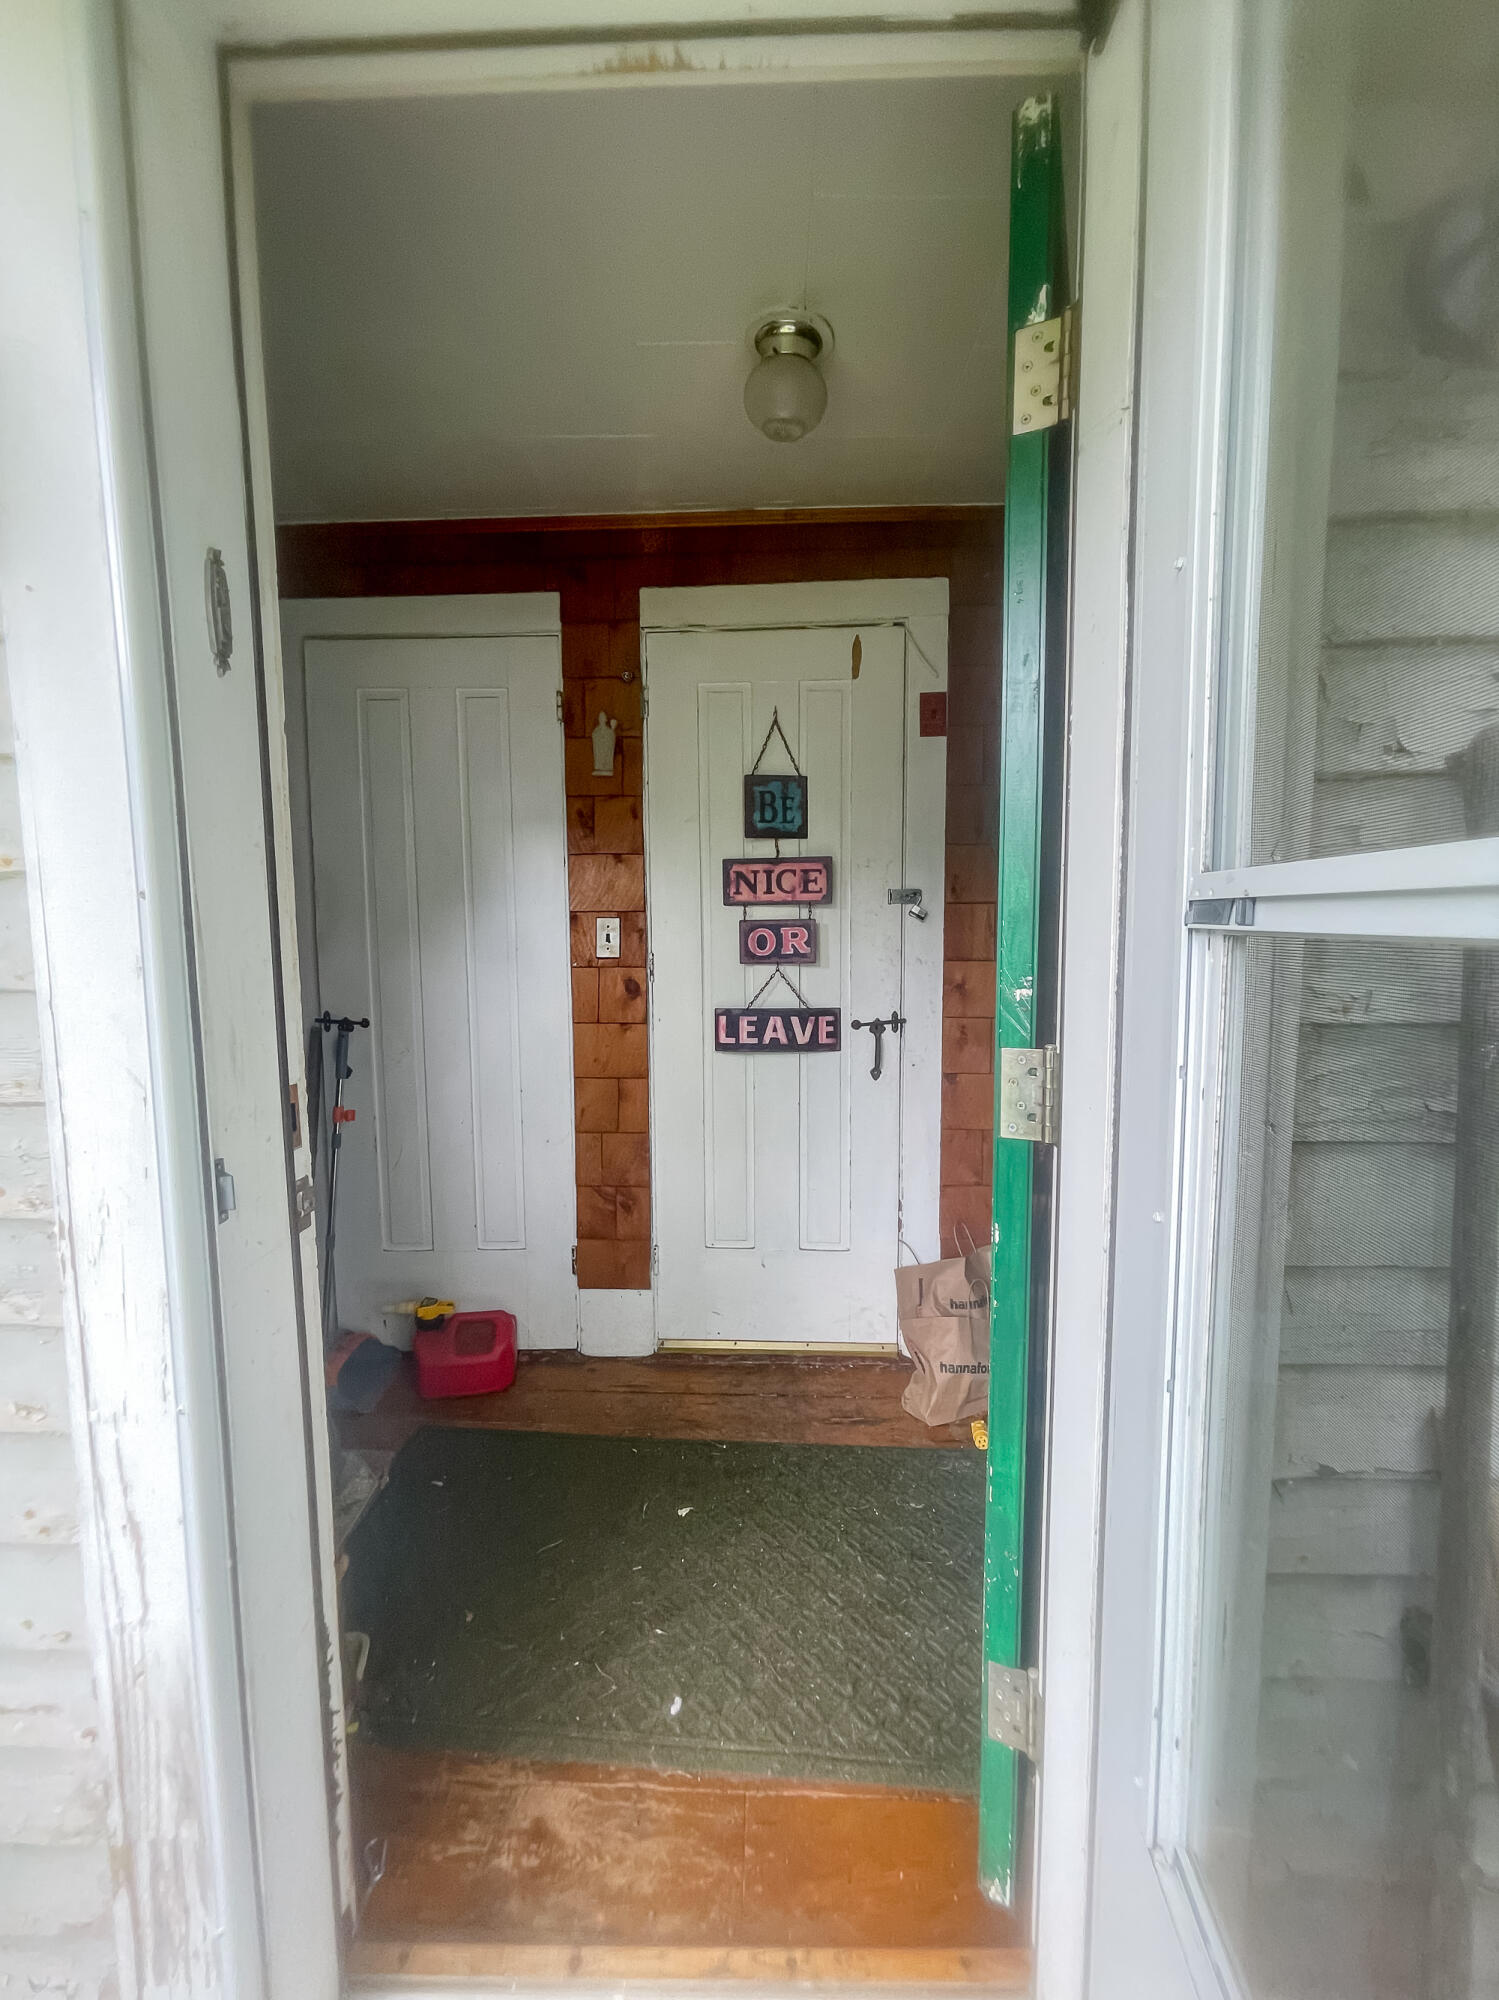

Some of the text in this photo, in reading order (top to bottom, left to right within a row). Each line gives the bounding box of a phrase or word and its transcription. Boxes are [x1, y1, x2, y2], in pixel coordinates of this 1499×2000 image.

[758, 790, 795, 825] BE
[732, 868, 823, 895] NICE
[747, 927, 811, 956] OR
[717, 1015, 837, 1045] LEAVE
